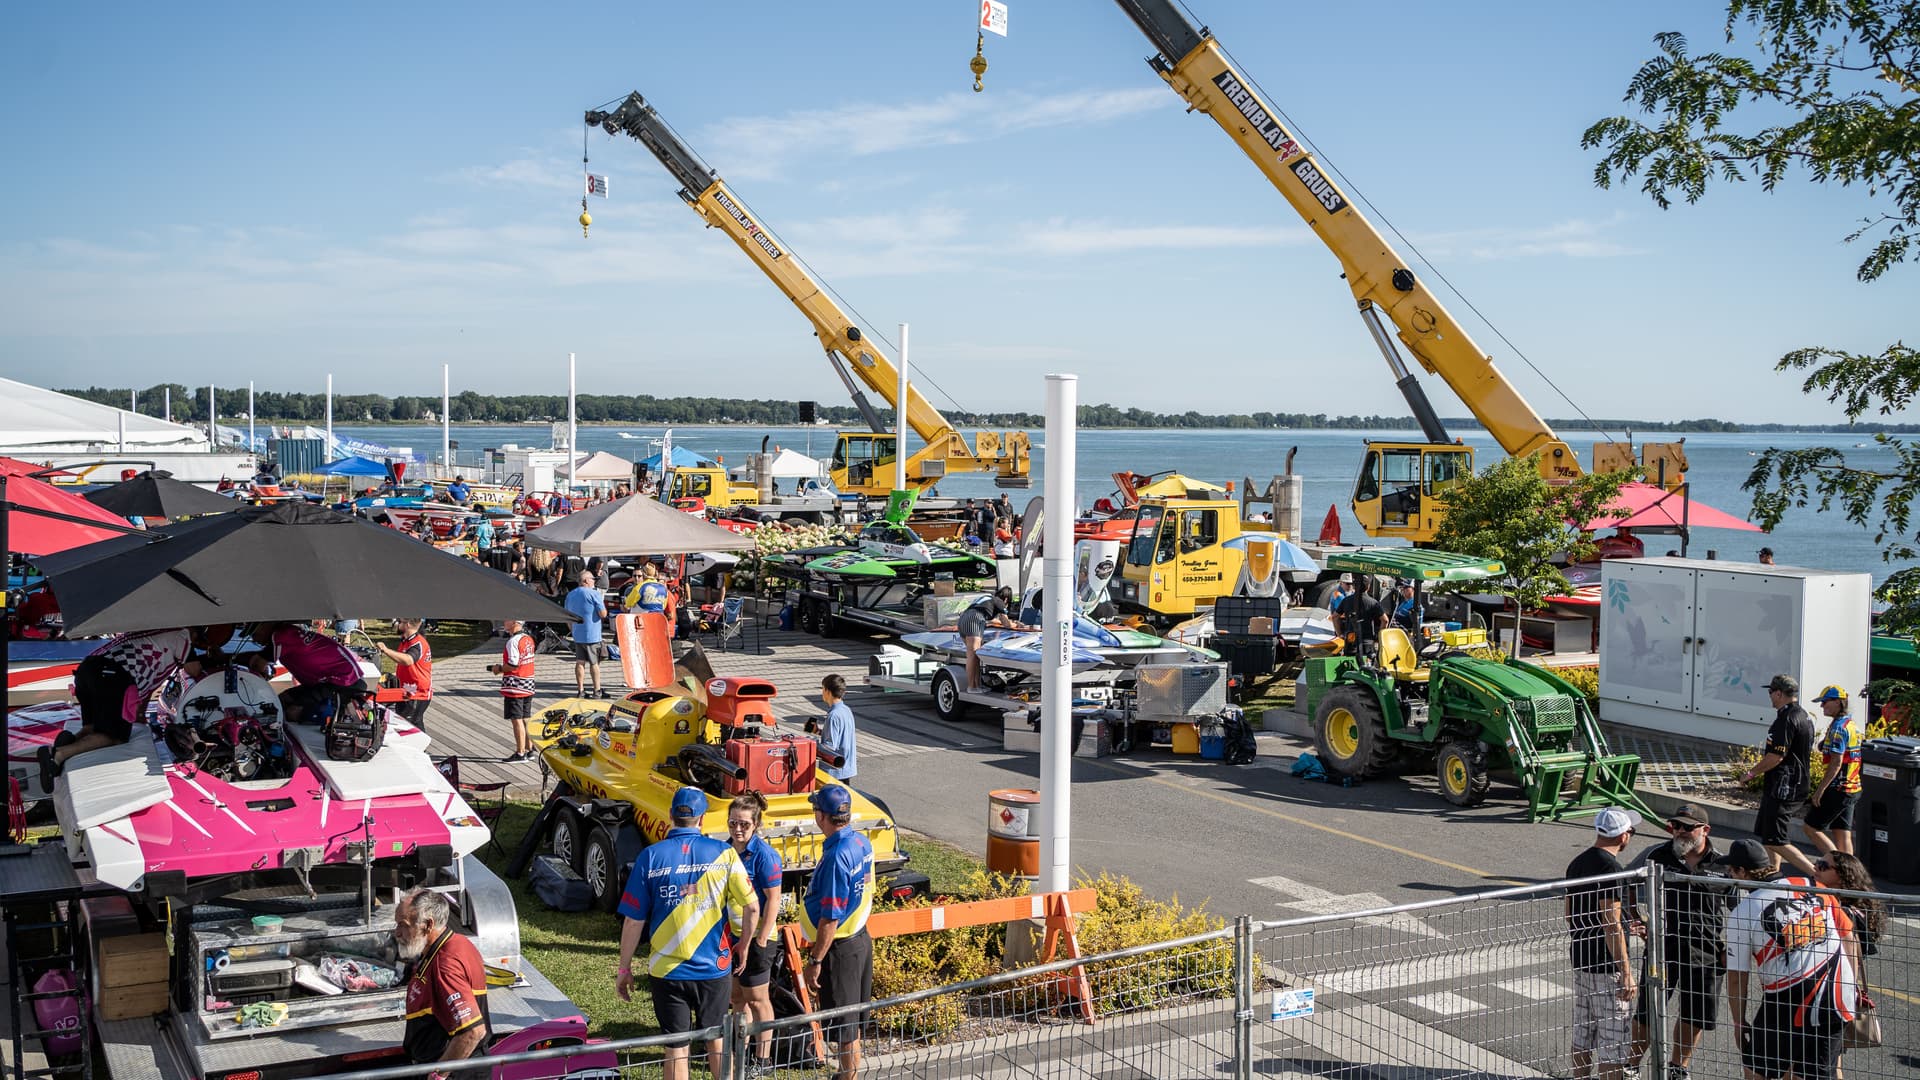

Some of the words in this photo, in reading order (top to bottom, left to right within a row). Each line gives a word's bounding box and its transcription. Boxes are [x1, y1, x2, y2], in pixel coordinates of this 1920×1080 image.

[982, 1, 991, 27] 2
[1217, 72, 1288, 150] TREMBLAY
[1295, 161, 1342, 211] GRUES
[588, 175, 595, 193] 3
[715, 191, 753, 230] TREMBLAY
[754, 232, 781, 260] GRUES
[659, 884, 678, 898] 52
